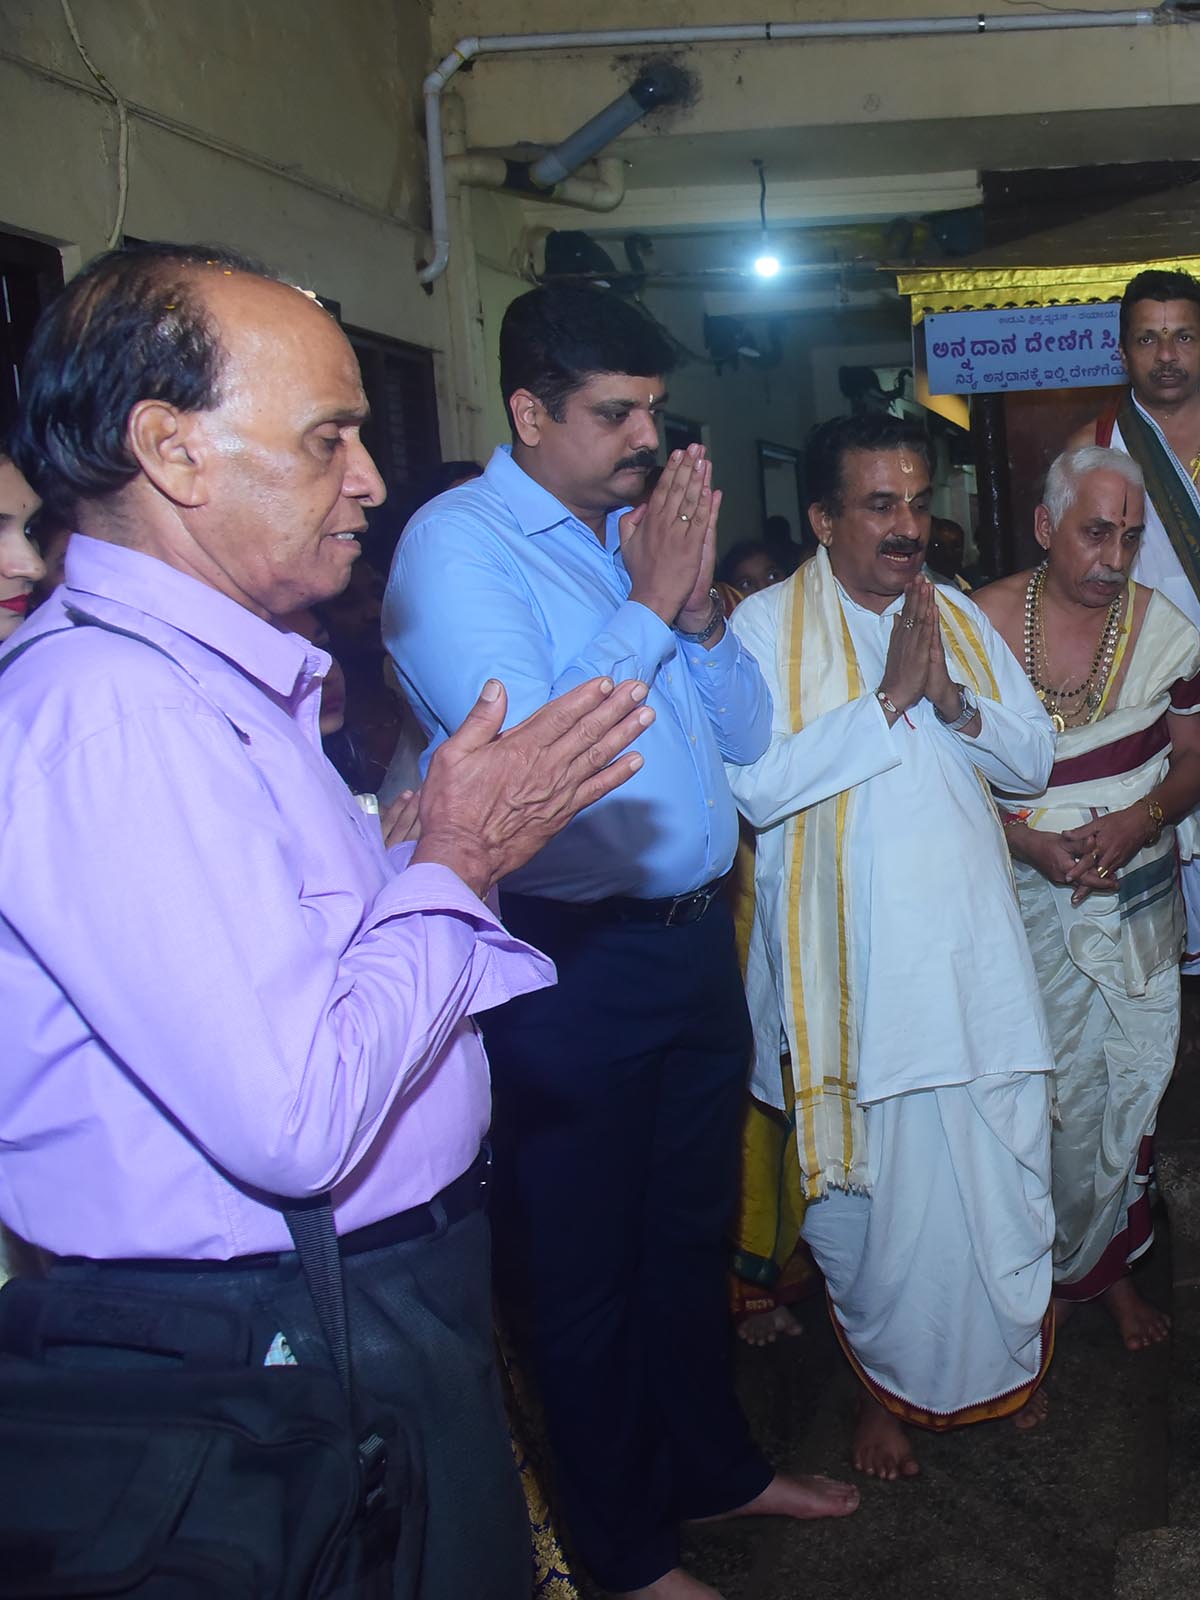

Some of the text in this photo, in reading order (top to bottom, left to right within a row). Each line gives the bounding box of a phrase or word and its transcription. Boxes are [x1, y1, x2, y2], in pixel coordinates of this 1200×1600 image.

[932, 333, 1017, 371] ಅನ್ನದಾನ
[1025, 328, 1093, 354] ದೇಣಿಗೆ
[955, 372, 979, 390] ನಿತ್ಯ
